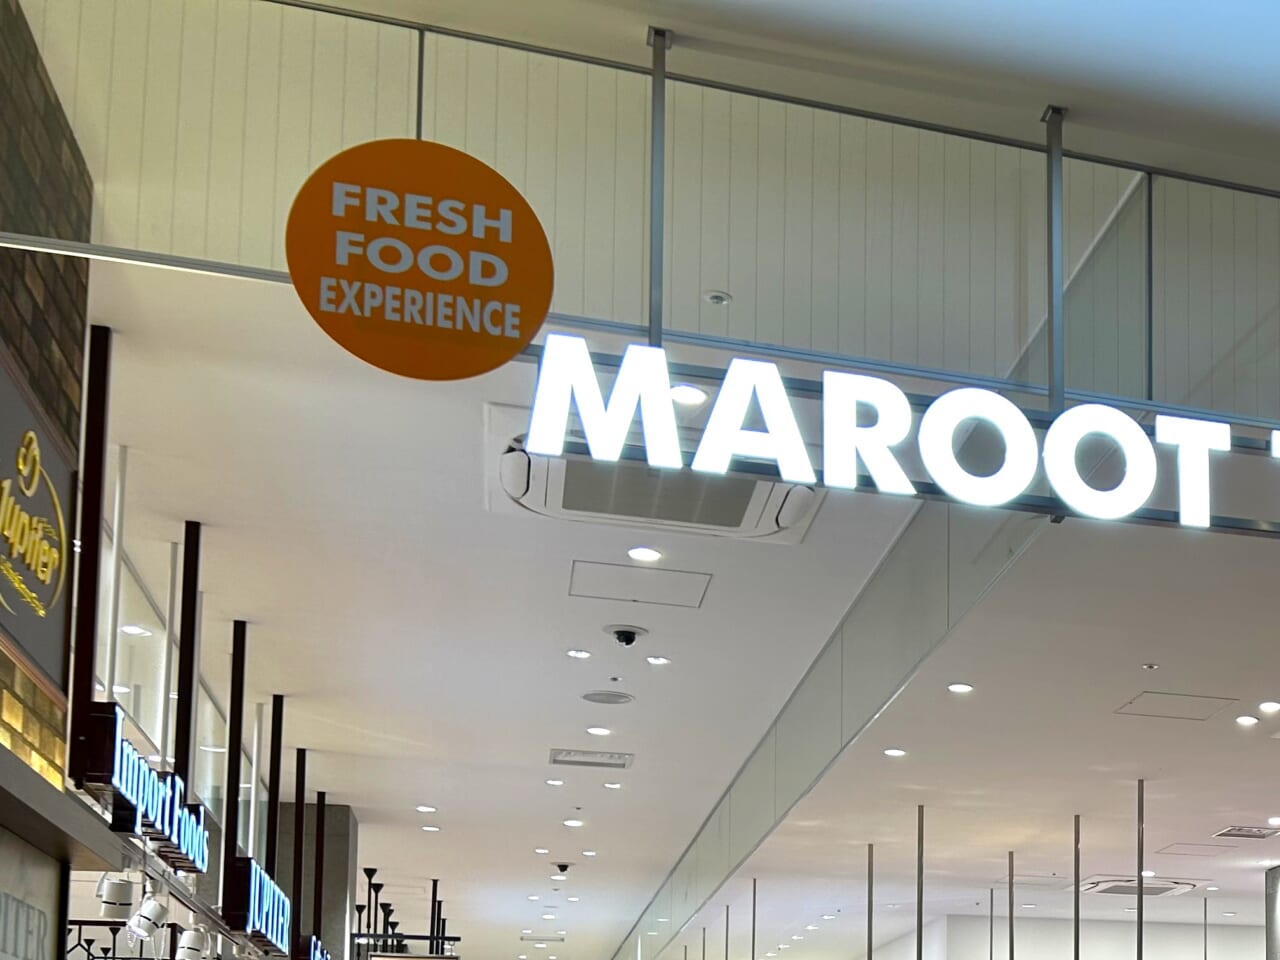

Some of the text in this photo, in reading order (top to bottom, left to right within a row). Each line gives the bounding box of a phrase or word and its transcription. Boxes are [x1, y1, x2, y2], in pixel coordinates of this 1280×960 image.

[331, 181, 512, 243] FRESH
[335, 230, 509, 287] FOOD
[319, 276, 521, 338] EXPERIENCE
[525, 333, 1231, 528] MAROOT
[112, 704, 209, 873] Import Foods
[246, 858, 291, 956] JUPITER
